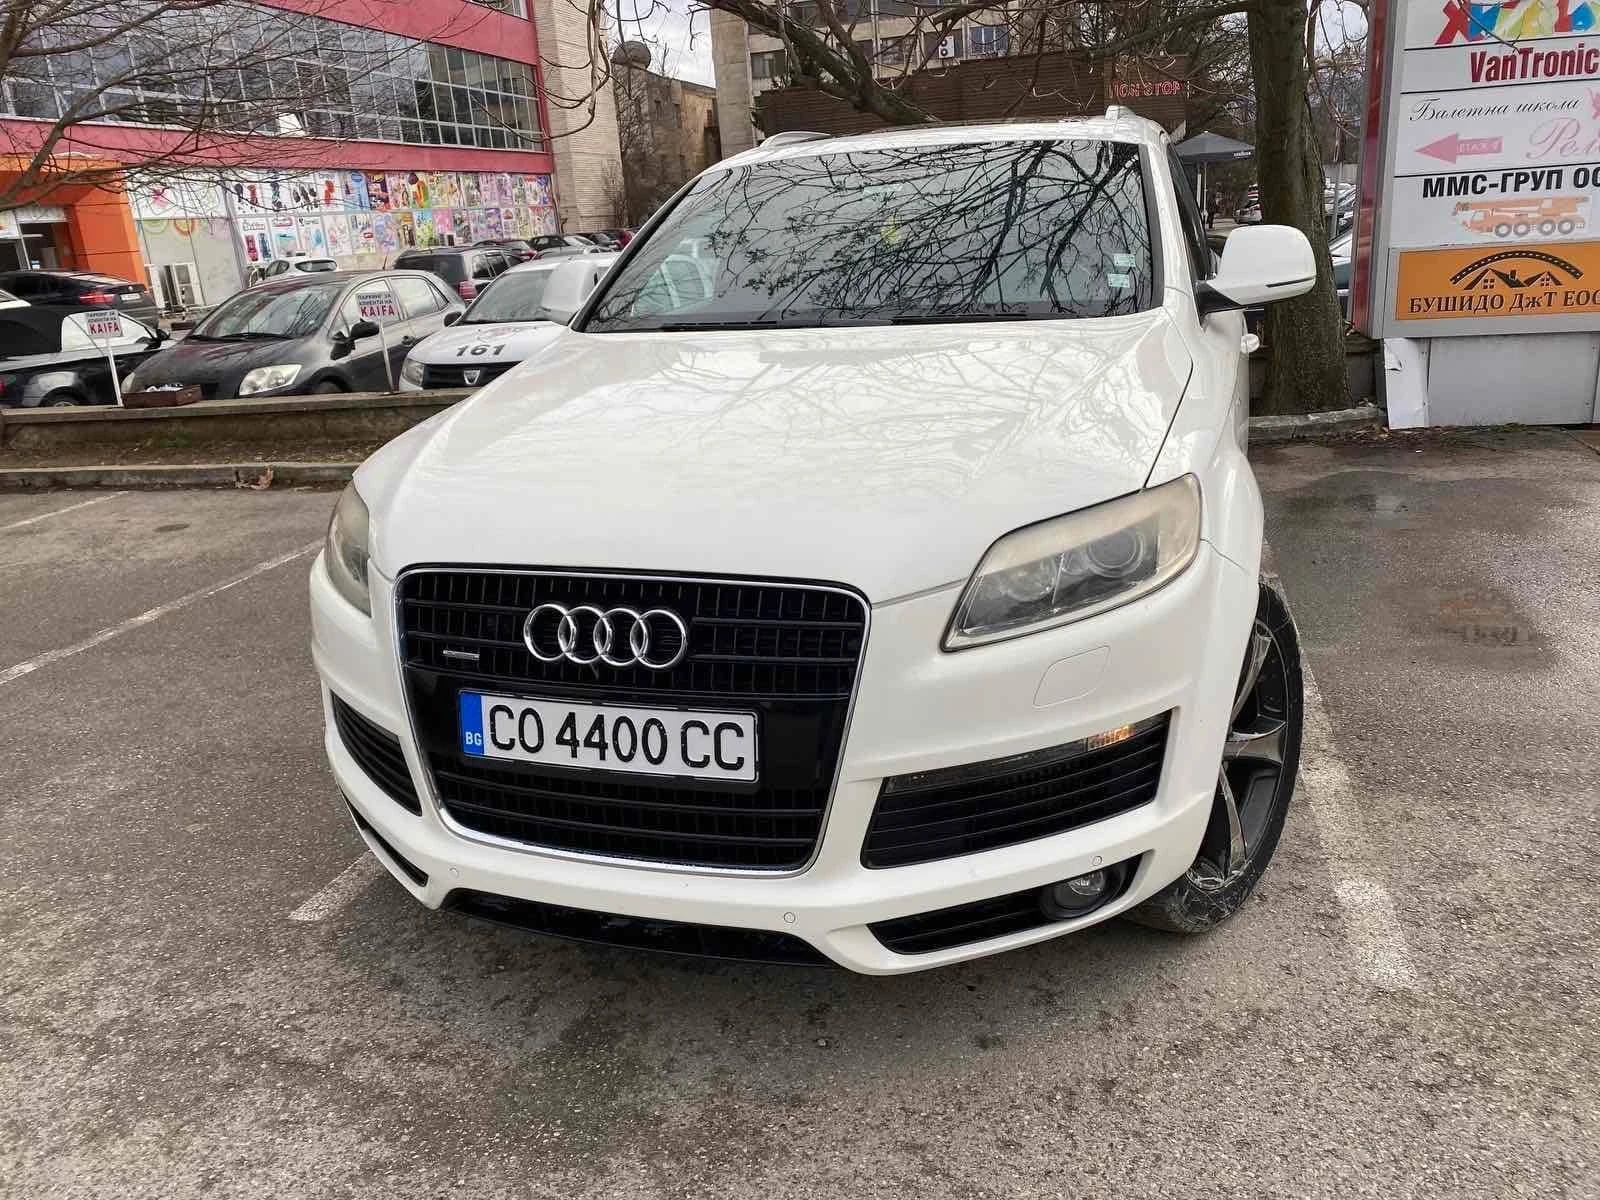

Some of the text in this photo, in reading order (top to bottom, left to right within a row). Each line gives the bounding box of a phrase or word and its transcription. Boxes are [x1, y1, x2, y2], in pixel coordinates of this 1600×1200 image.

[1423, 169, 1563, 198] ММС-ГРУП
[361, 305, 395, 317] KAIFA
[1410, 293, 1504, 314] БУШИДО
[90, 322, 119, 334] KAIFA
[456, 343, 506, 357] 161
[465, 731, 482, 746] BG
[489, 704, 745, 771] CO 4400 CC
